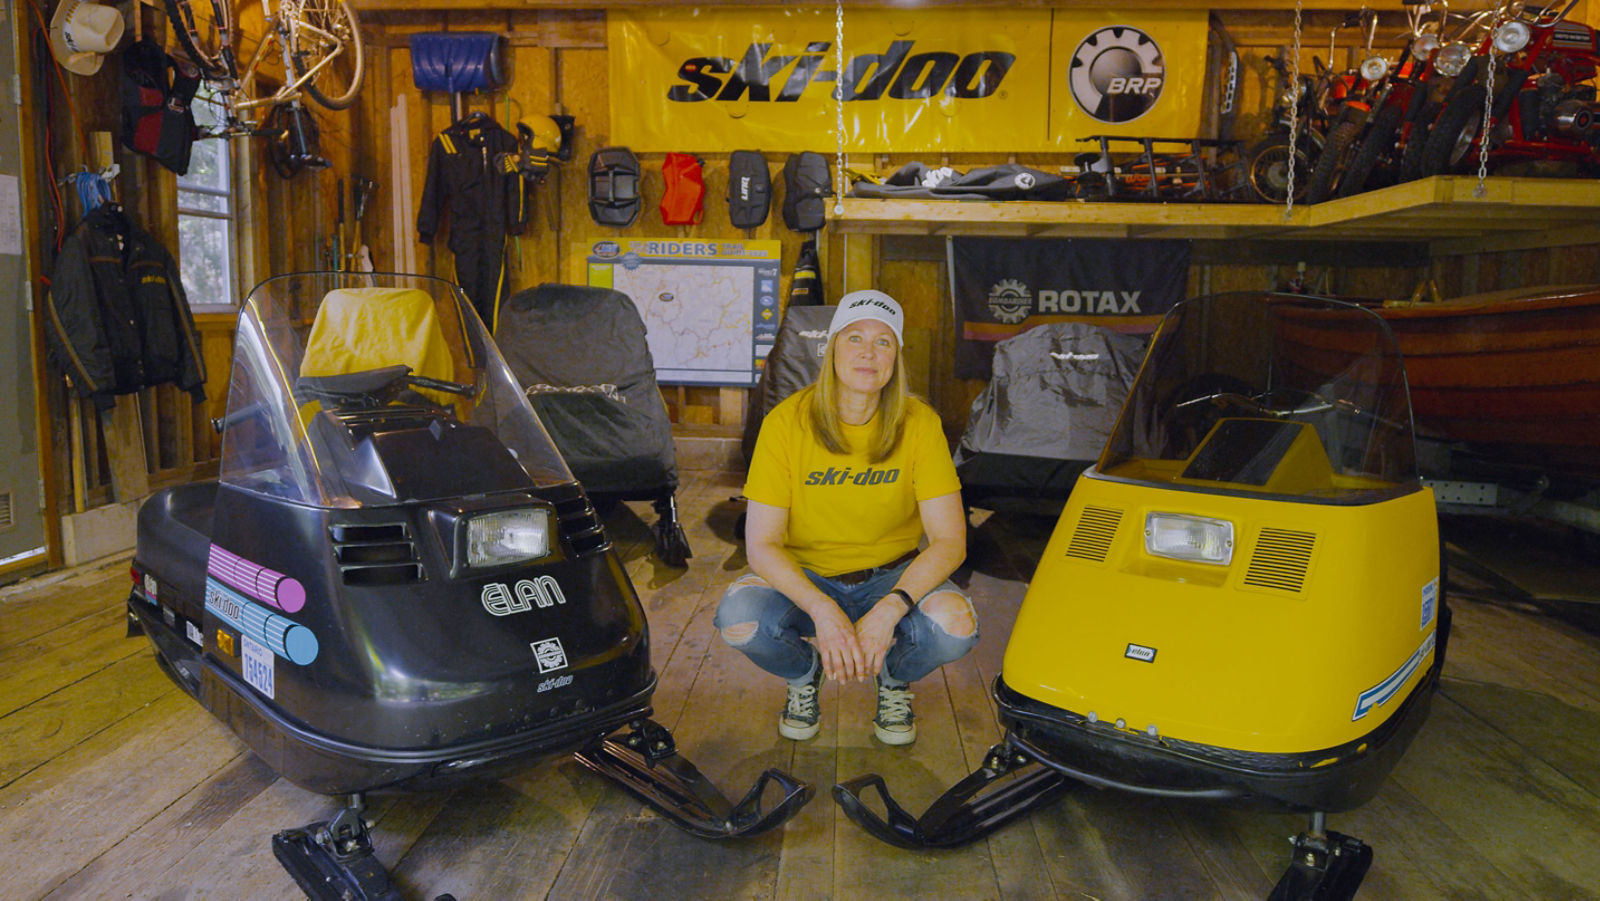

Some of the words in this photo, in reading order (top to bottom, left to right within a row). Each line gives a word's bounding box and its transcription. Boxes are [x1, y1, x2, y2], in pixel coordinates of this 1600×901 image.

[667, 40, 1017, 102] ski-doo
[1107, 77, 1162, 94] BRP
[648, 242, 718, 256] RIDERS
[848, 297, 896, 316] ski-doo
[1038, 289, 1142, 313] ROTAX
[804, 466, 901, 486] ski-doo
